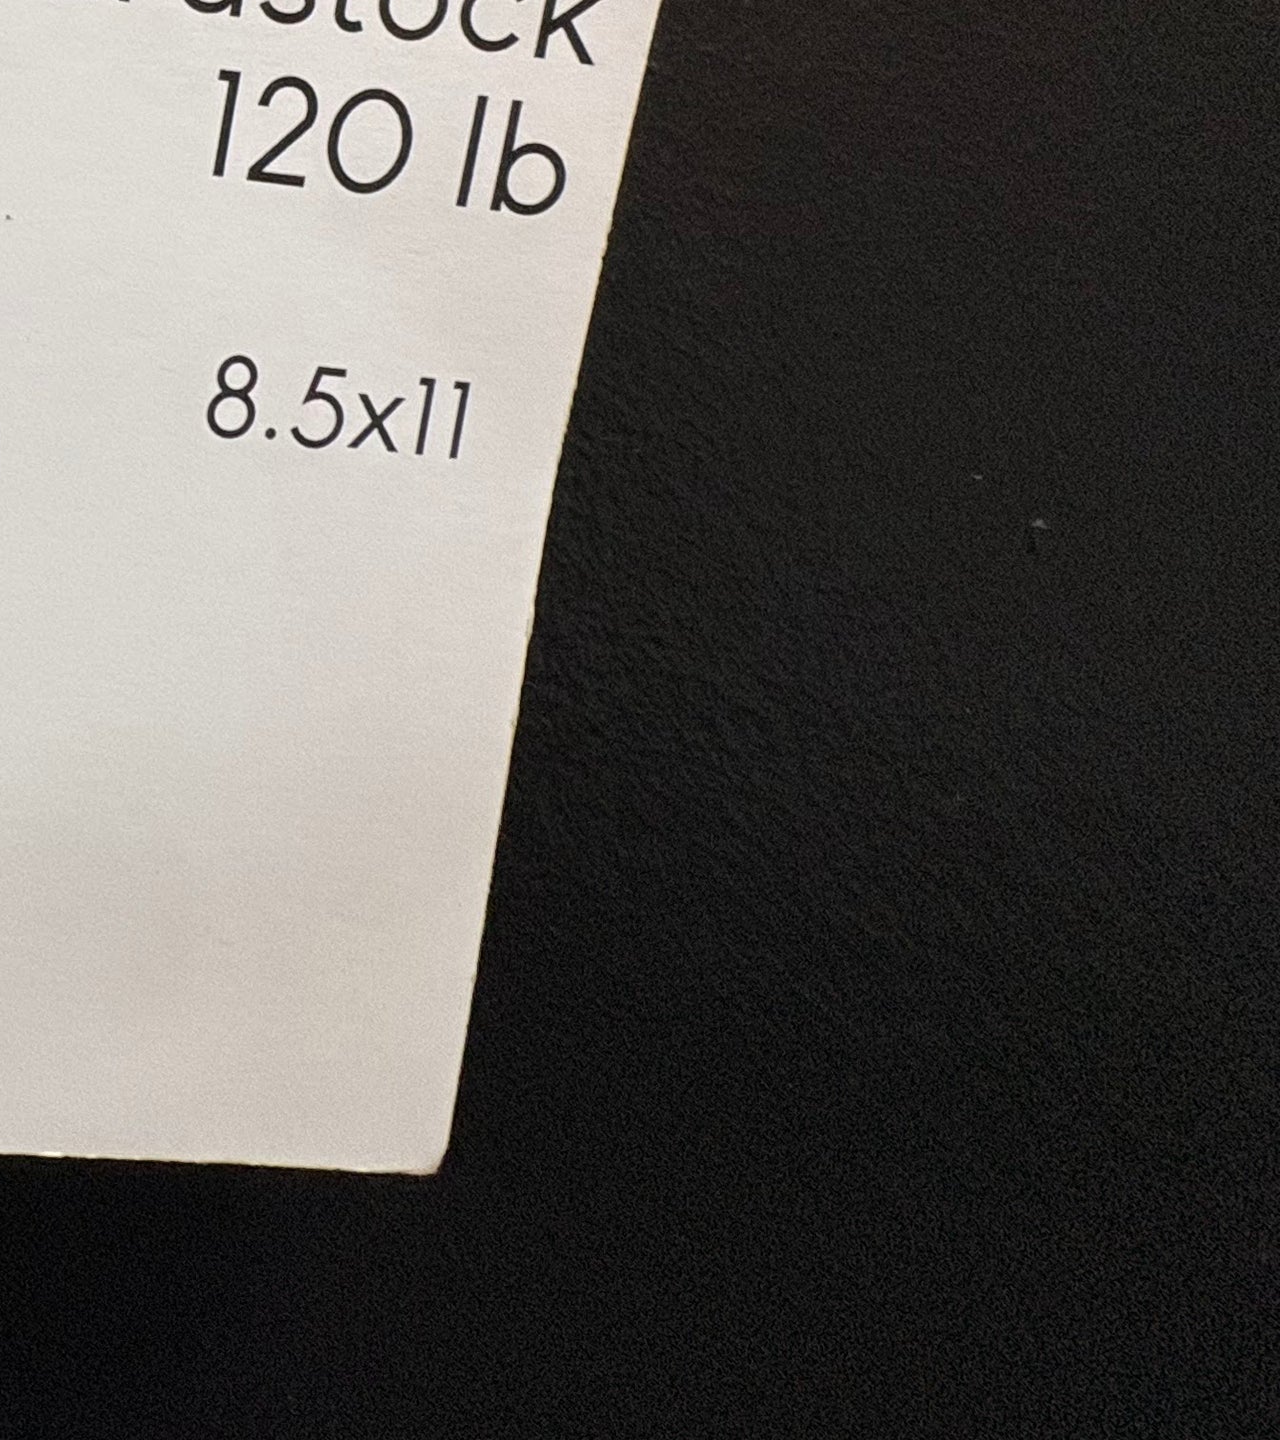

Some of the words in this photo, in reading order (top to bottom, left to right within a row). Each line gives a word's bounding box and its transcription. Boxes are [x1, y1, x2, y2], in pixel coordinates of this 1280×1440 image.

[212, 69, 414, 194] 120
[455, 95, 567, 216] lb
[206, 354, 472, 459] 8.5x11
